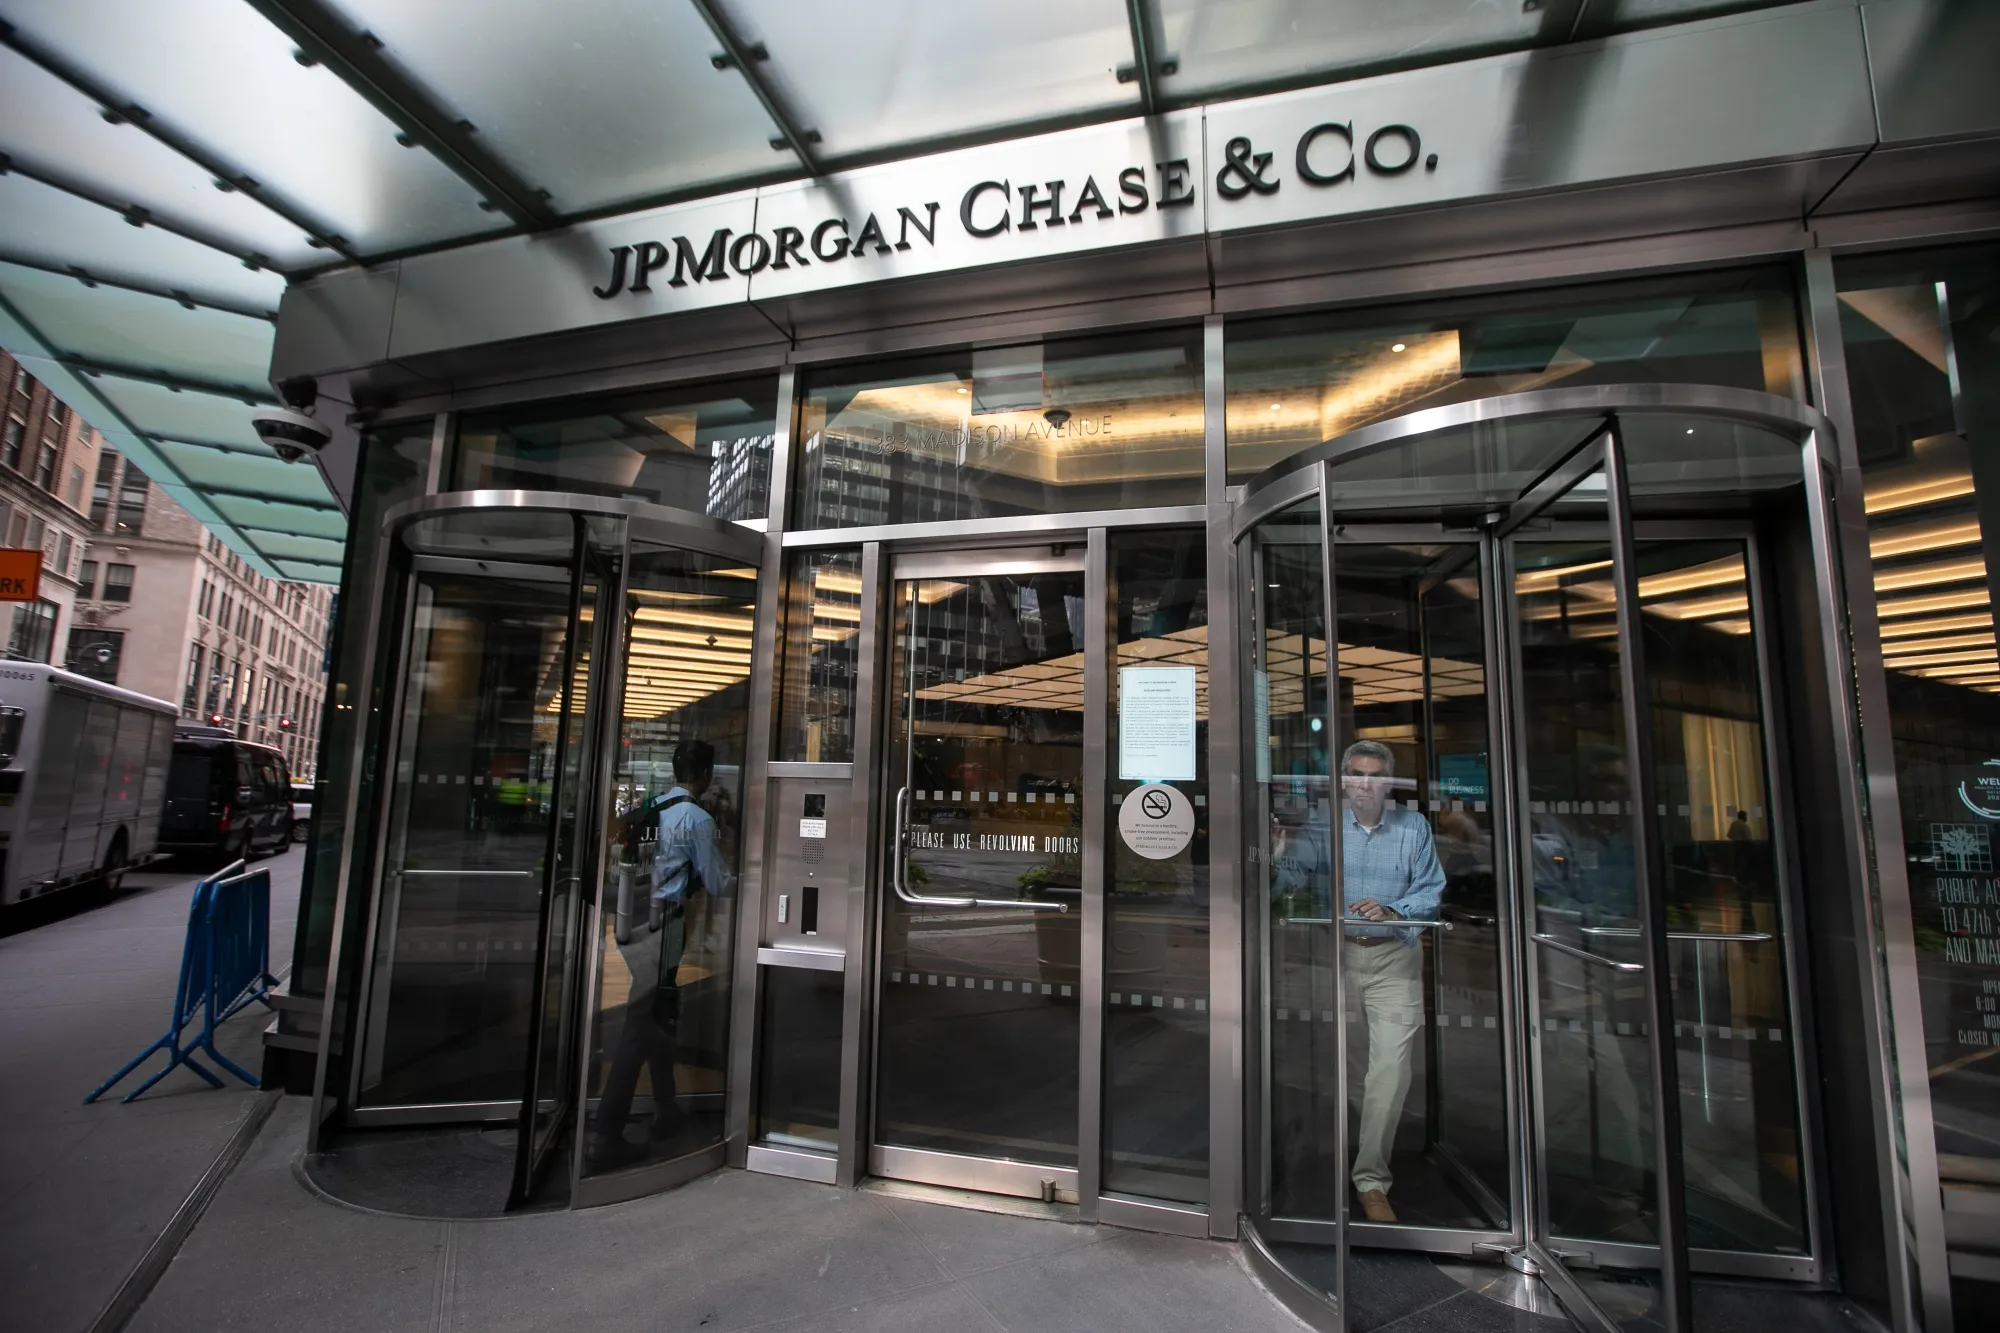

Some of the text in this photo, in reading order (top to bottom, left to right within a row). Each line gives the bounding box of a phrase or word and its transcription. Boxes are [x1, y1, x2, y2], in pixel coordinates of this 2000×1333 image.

[959, 157, 1196, 239] CHASE
[1216, 136, 1281, 198] &
[873, 414, 1114, 456] 383 MADISON AVENUE
[1448, 785, 1485, 795] BUSINESS
[910, 832, 1079, 854] PLEASE USE REVOLVING DOORS
[1936, 877, 1980, 905] PUBLIC
[1940, 906, 1958, 933] TO
[1963, 907, 1992, 935] 47th
[1945, 936, 1972, 964] AND
[1975, 995, 1996, 1013] 6:00
[1958, 1028, 1989, 1046] CLOSED
